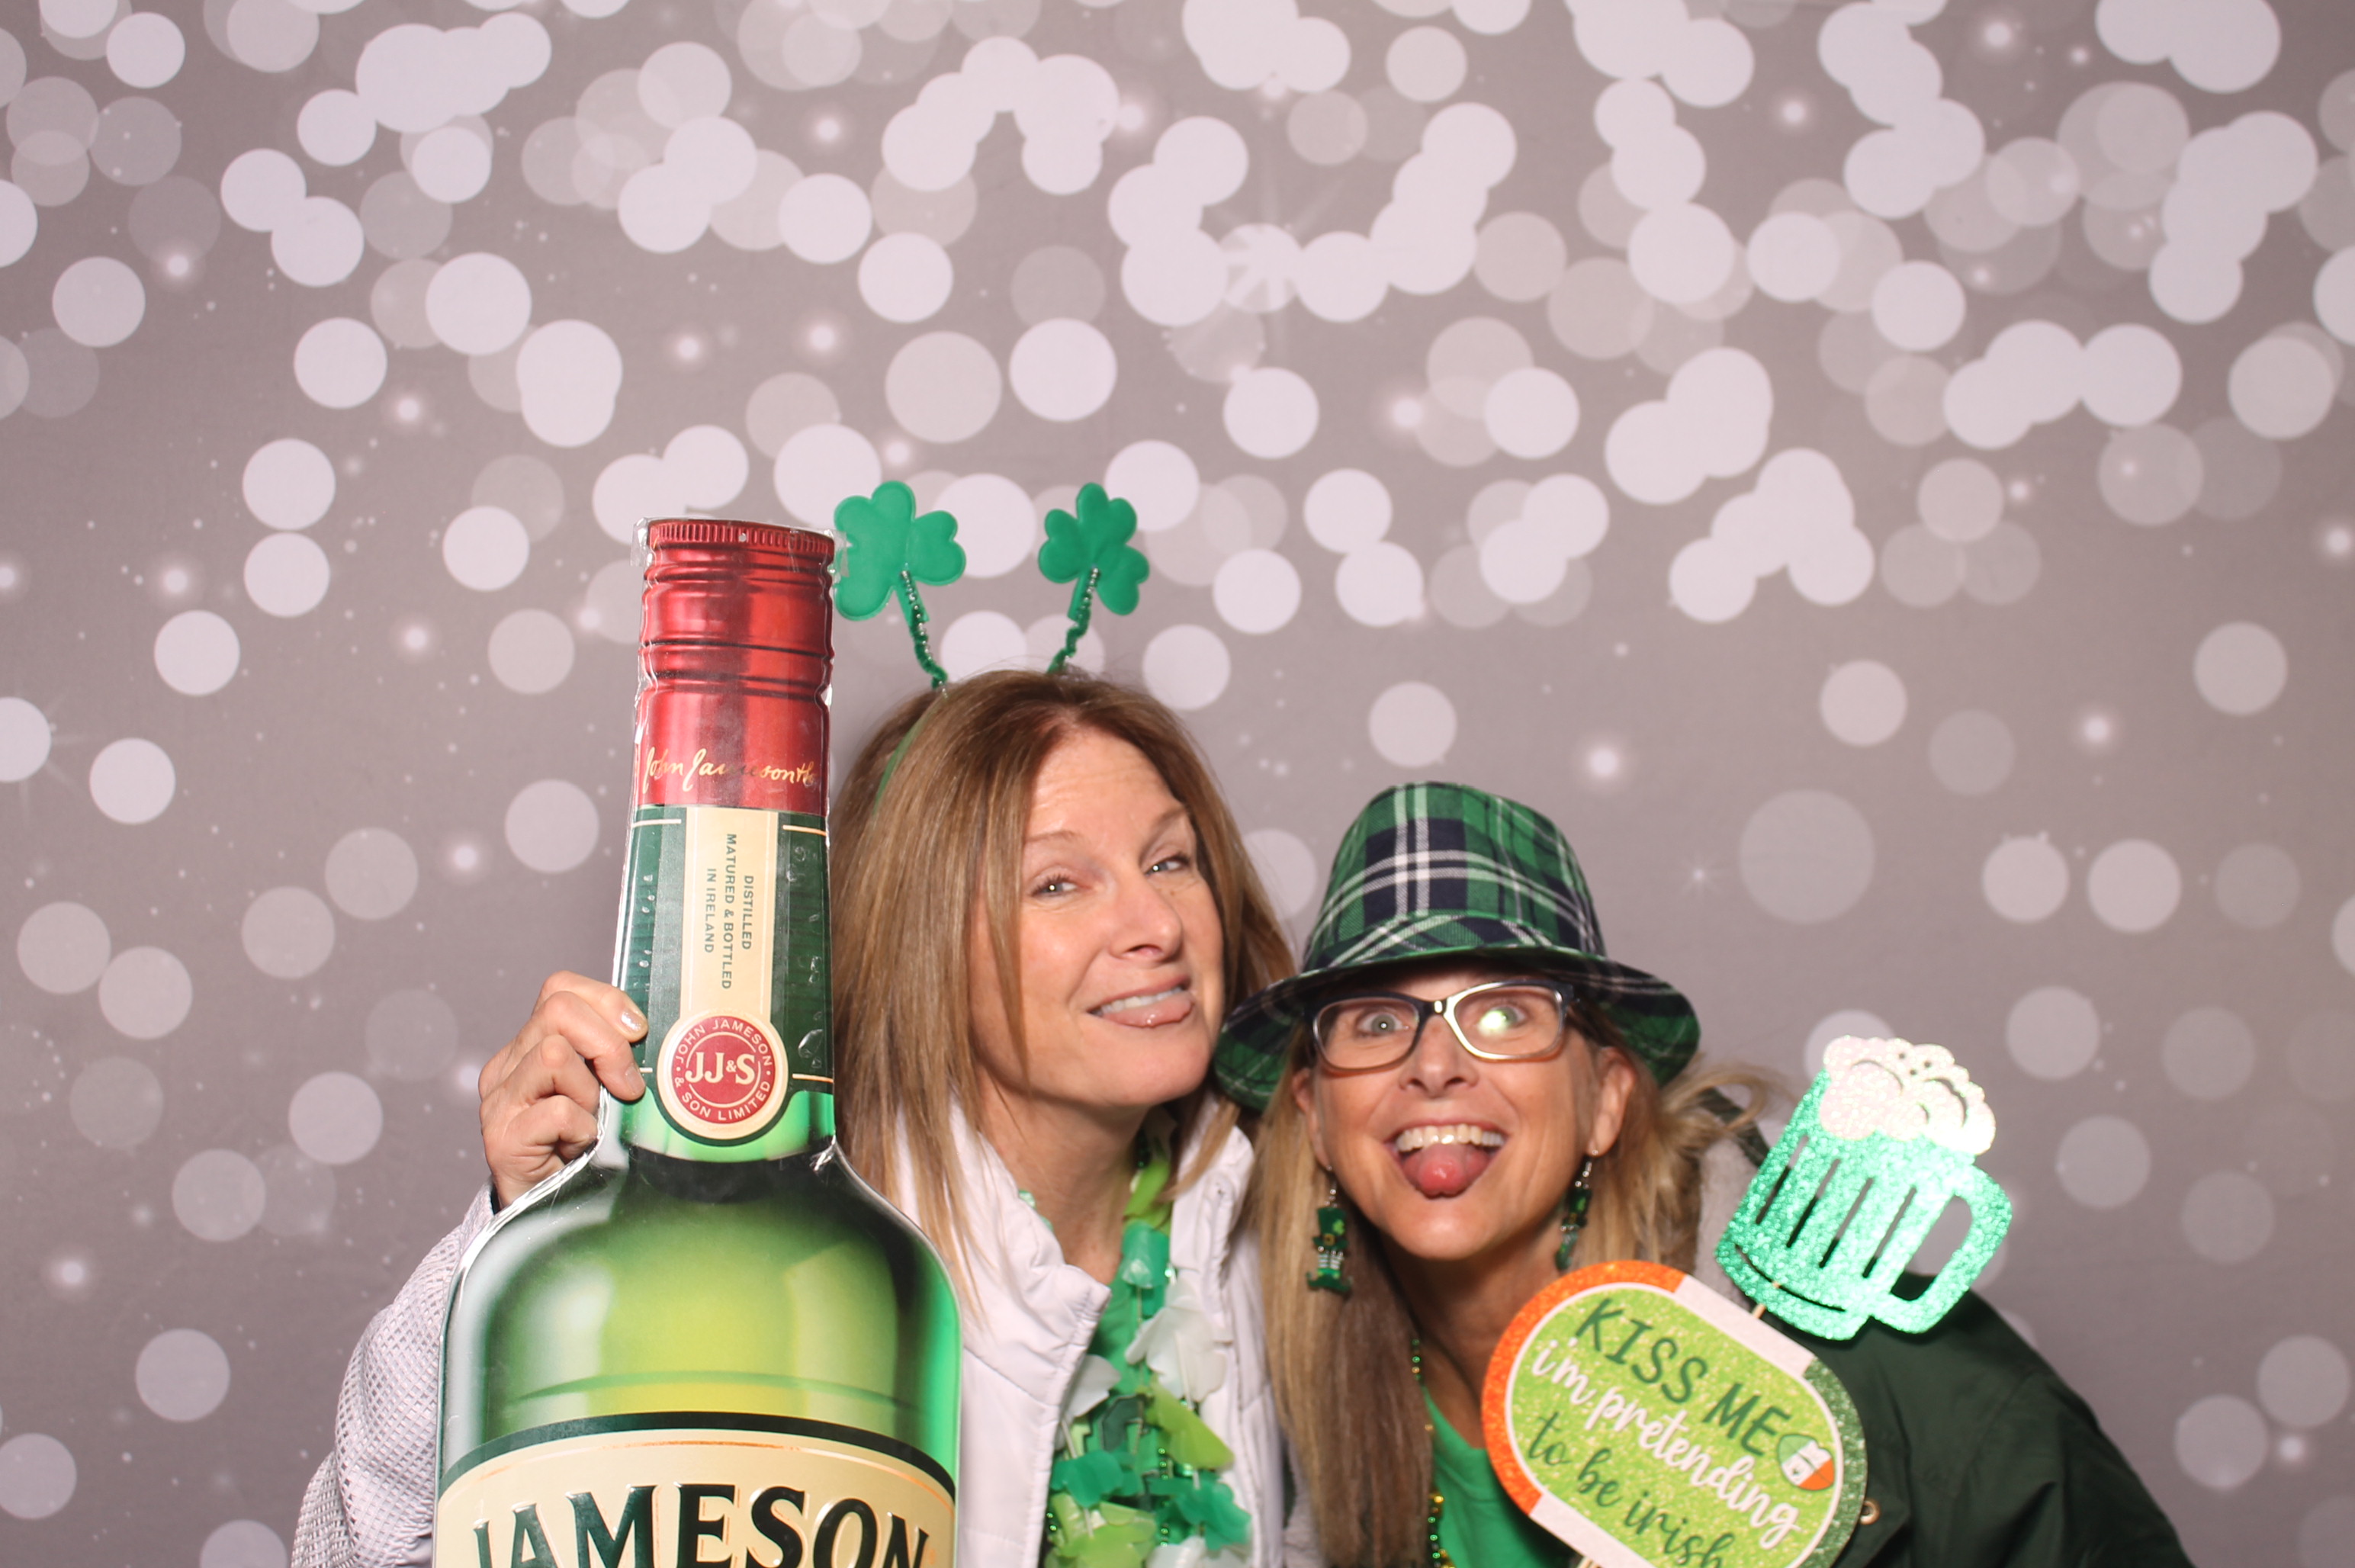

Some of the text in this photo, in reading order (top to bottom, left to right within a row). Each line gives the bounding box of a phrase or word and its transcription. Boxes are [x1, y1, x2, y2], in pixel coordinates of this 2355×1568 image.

[642, 747, 683, 794] John
[705, 868, 716, 953] IN IRELAND
[721, 834, 737, 989] MATURED & BOTTLED
[741, 876, 753, 950] DISTILLED
[675, 1019, 773, 1066] JOHN JAMESON
[685, 1052, 756, 1084] JJ&S
[675, 1077, 771, 1120] & SON LIMITED
[1573, 1298, 1794, 1457] KISS ME
[1528, 1412, 1735, 1568] to be irish
[1584, 1386, 1803, 1550] pretending
